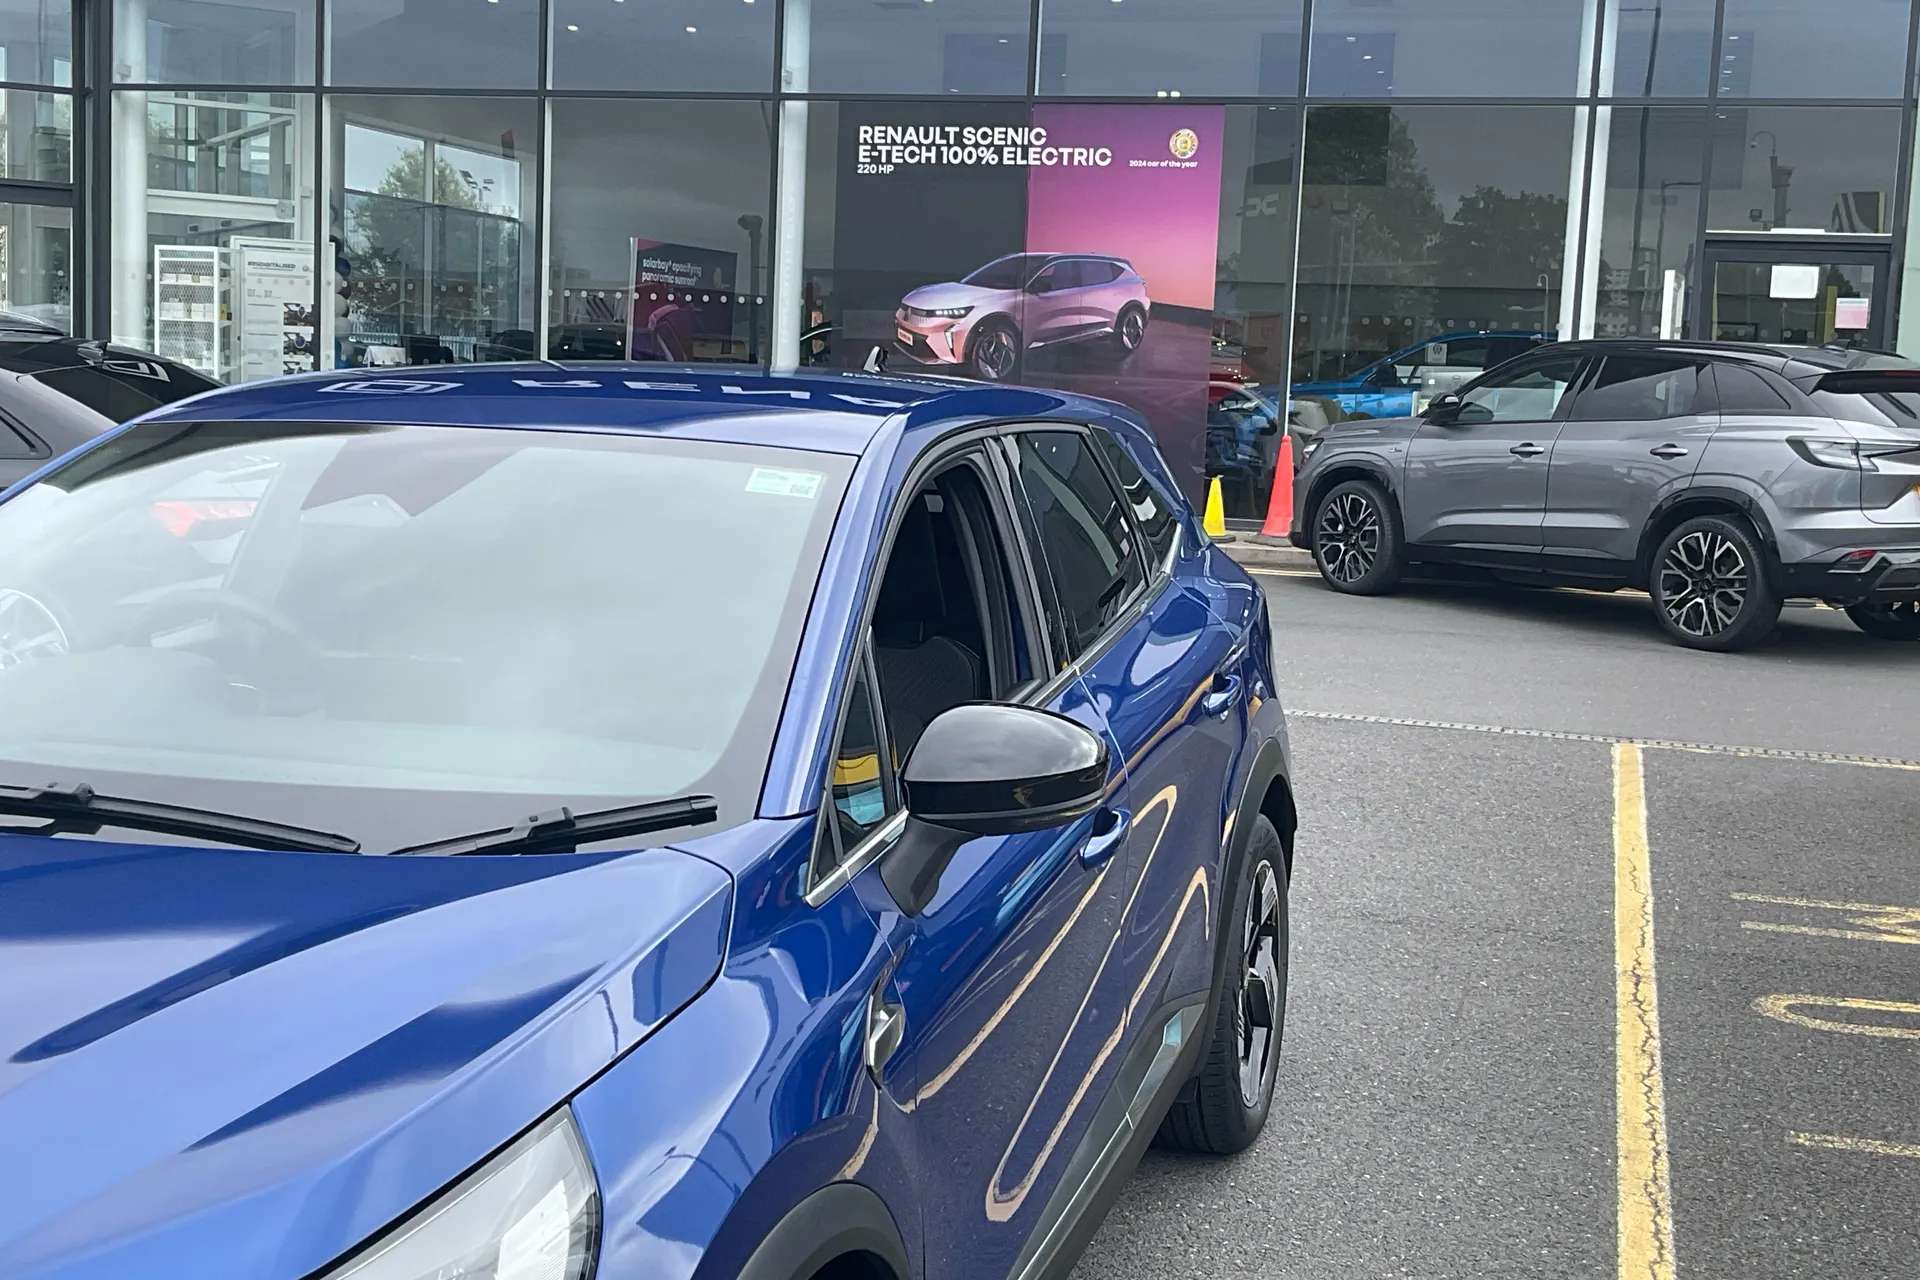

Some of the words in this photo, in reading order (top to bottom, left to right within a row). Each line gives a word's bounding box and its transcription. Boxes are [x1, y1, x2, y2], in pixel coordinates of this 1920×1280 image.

[859, 125, 959, 144] RENAULT
[962, 126, 1047, 145] SCENIC
[858, 144, 936, 163] E-TECH
[940, 145, 999, 164] 100%
[1002, 146, 1113, 166] ELECTRIC
[857, 164, 877, 174] 220
[878, 164, 895, 174] HP
[1129, 160, 1146, 168] 2024
[1160, 160, 1169, 168] of
[1169, 160, 1181, 168] the
[1181, 161, 1198, 169] year
[641, 271, 674, 283] panoramic
